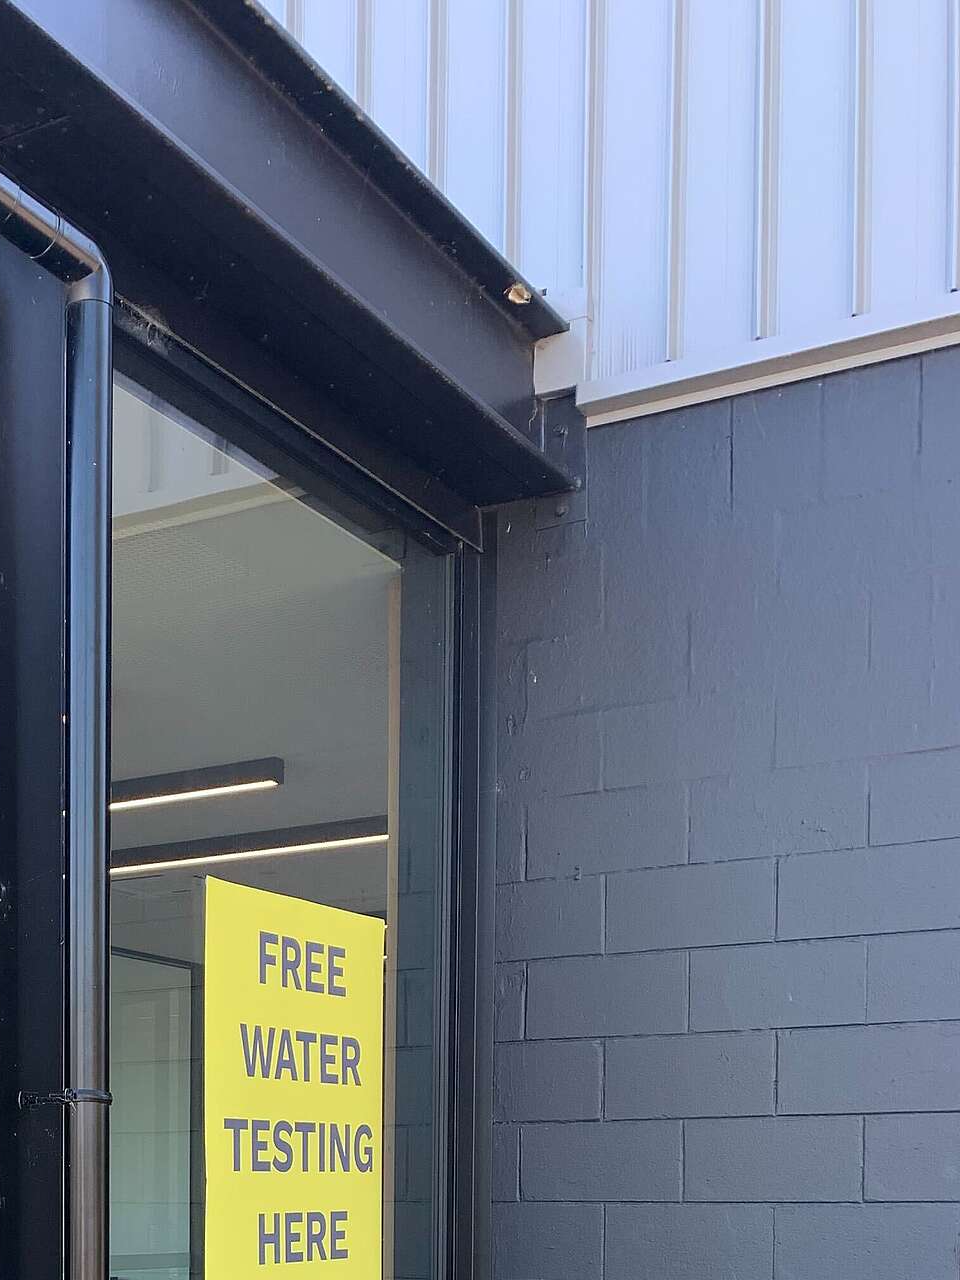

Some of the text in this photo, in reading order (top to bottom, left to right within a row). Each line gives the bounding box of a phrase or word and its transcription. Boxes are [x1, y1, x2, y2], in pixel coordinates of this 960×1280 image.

[259, 931, 346, 997] FREE
[240, 1023, 362, 1087] WATER
[224, 1118, 373, 1173] TESTING
[258, 1211, 348, 1265] HERE
